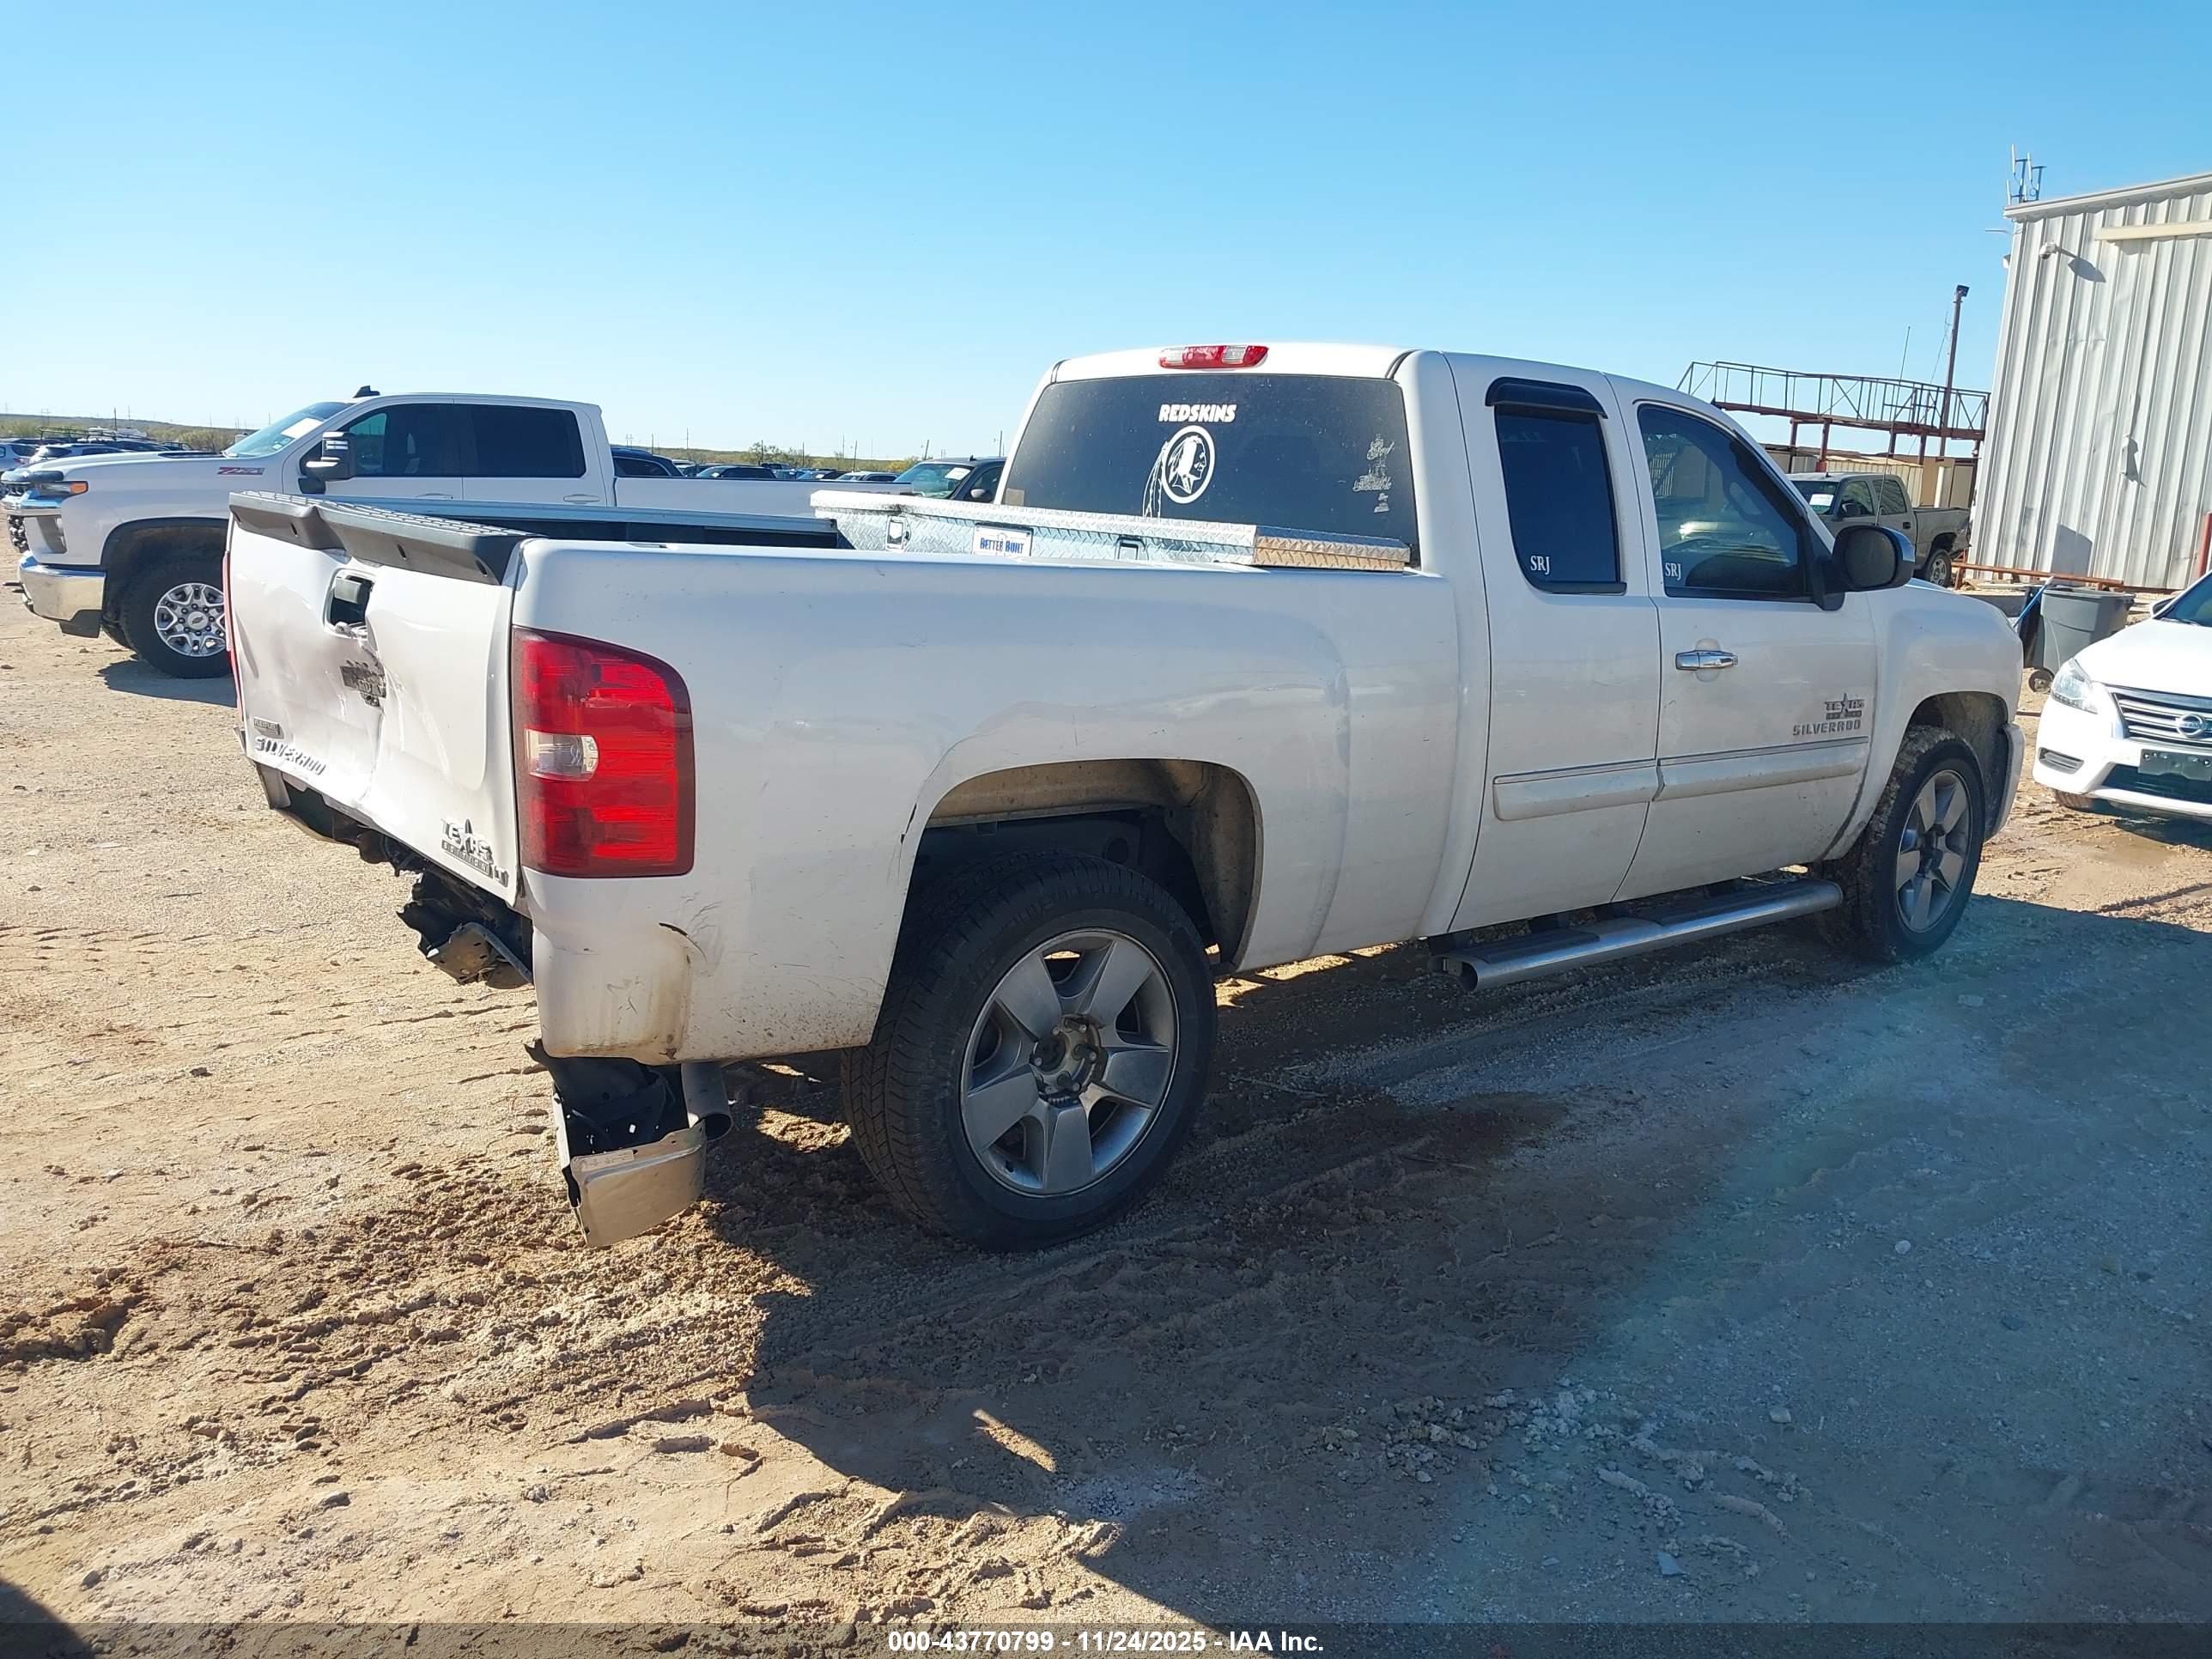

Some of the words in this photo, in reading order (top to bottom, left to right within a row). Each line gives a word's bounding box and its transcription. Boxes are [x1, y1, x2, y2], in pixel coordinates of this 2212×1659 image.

[1158, 404, 1237, 422] REDSKINS
[980, 537, 1004, 552] BETTER
[1005, 540, 1024, 554] BUILT
[1530, 556, 1550, 575] SRJ
[1665, 562, 1681, 581] SRJ
[1792, 719, 1862, 736] SILVERADO
[255, 737, 327, 776] SILVERADO
